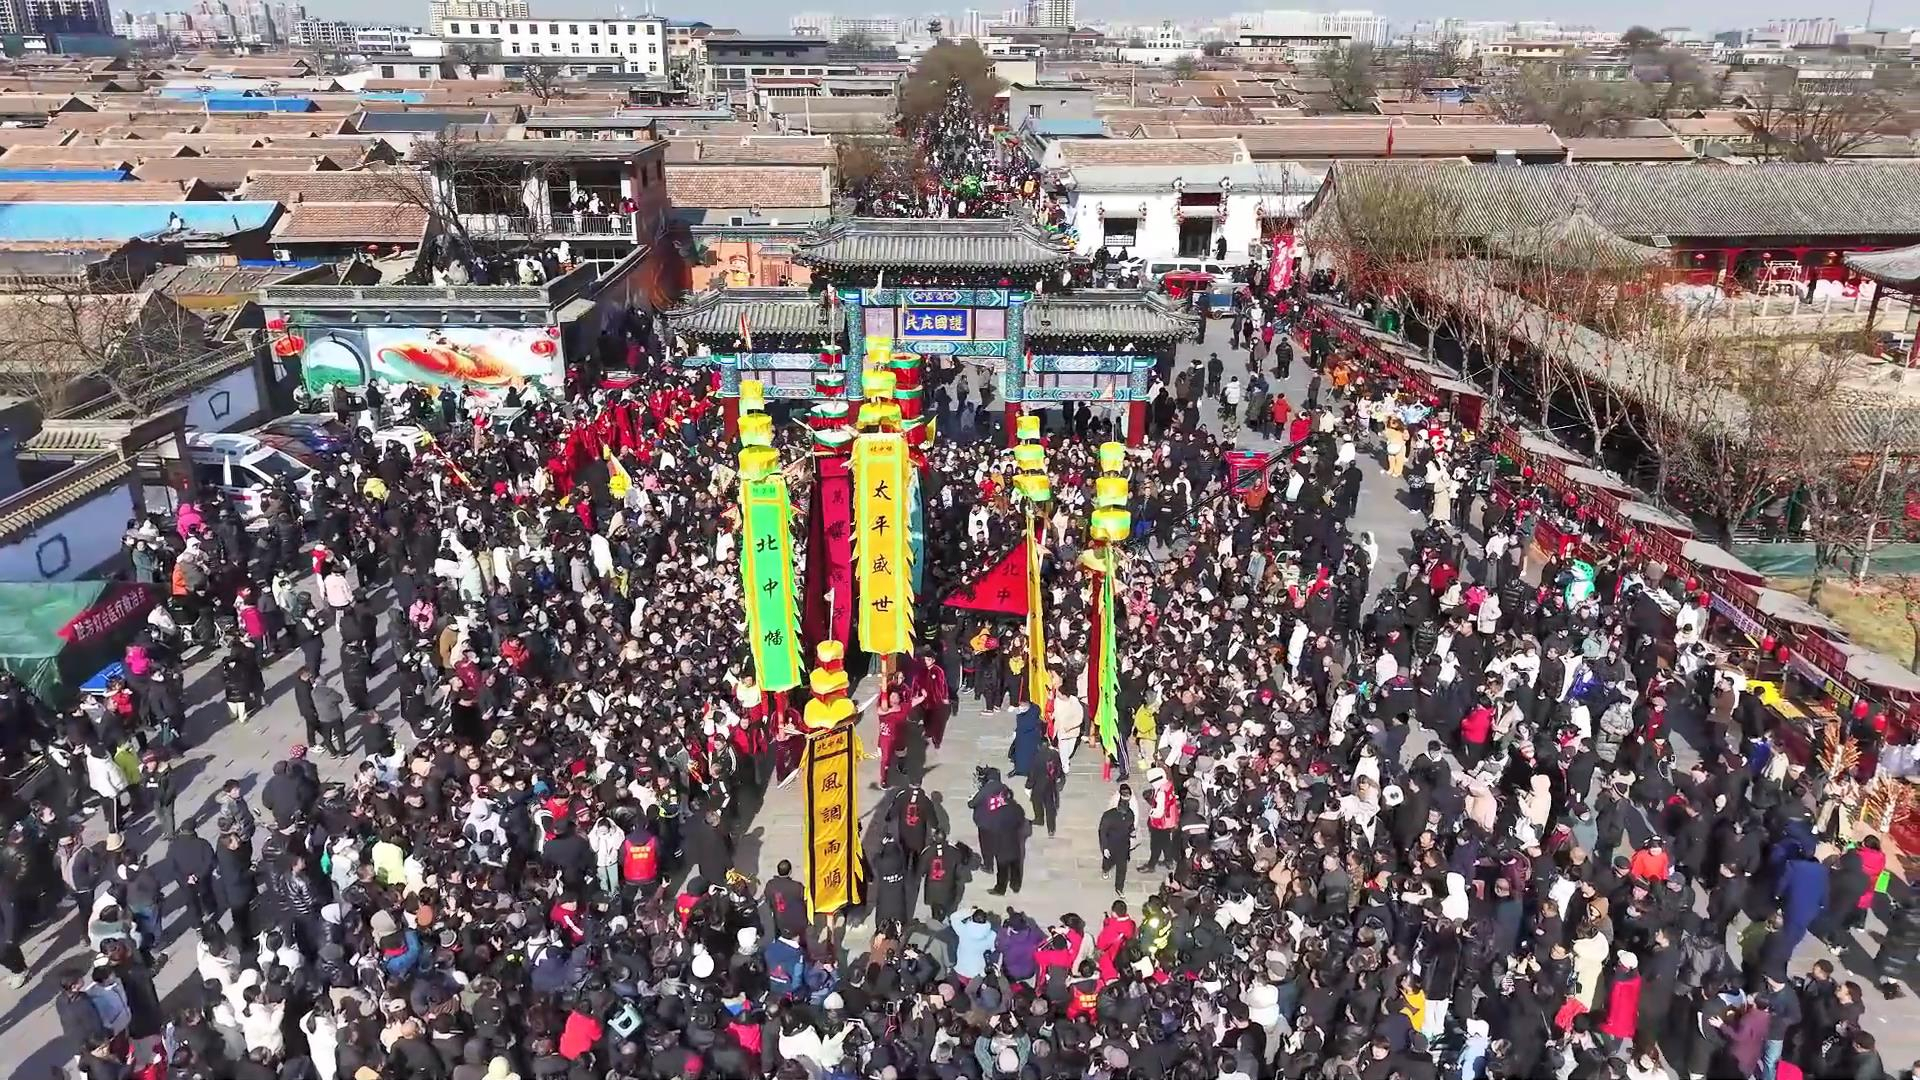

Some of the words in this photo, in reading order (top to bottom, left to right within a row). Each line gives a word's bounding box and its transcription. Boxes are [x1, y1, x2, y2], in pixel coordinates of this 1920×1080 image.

[756, 534, 784, 646] 北中幡
[871, 480, 893, 613] 太平盛世
[997, 563, 1018, 604] 北中
[820, 772, 843, 889] 風調雨順
